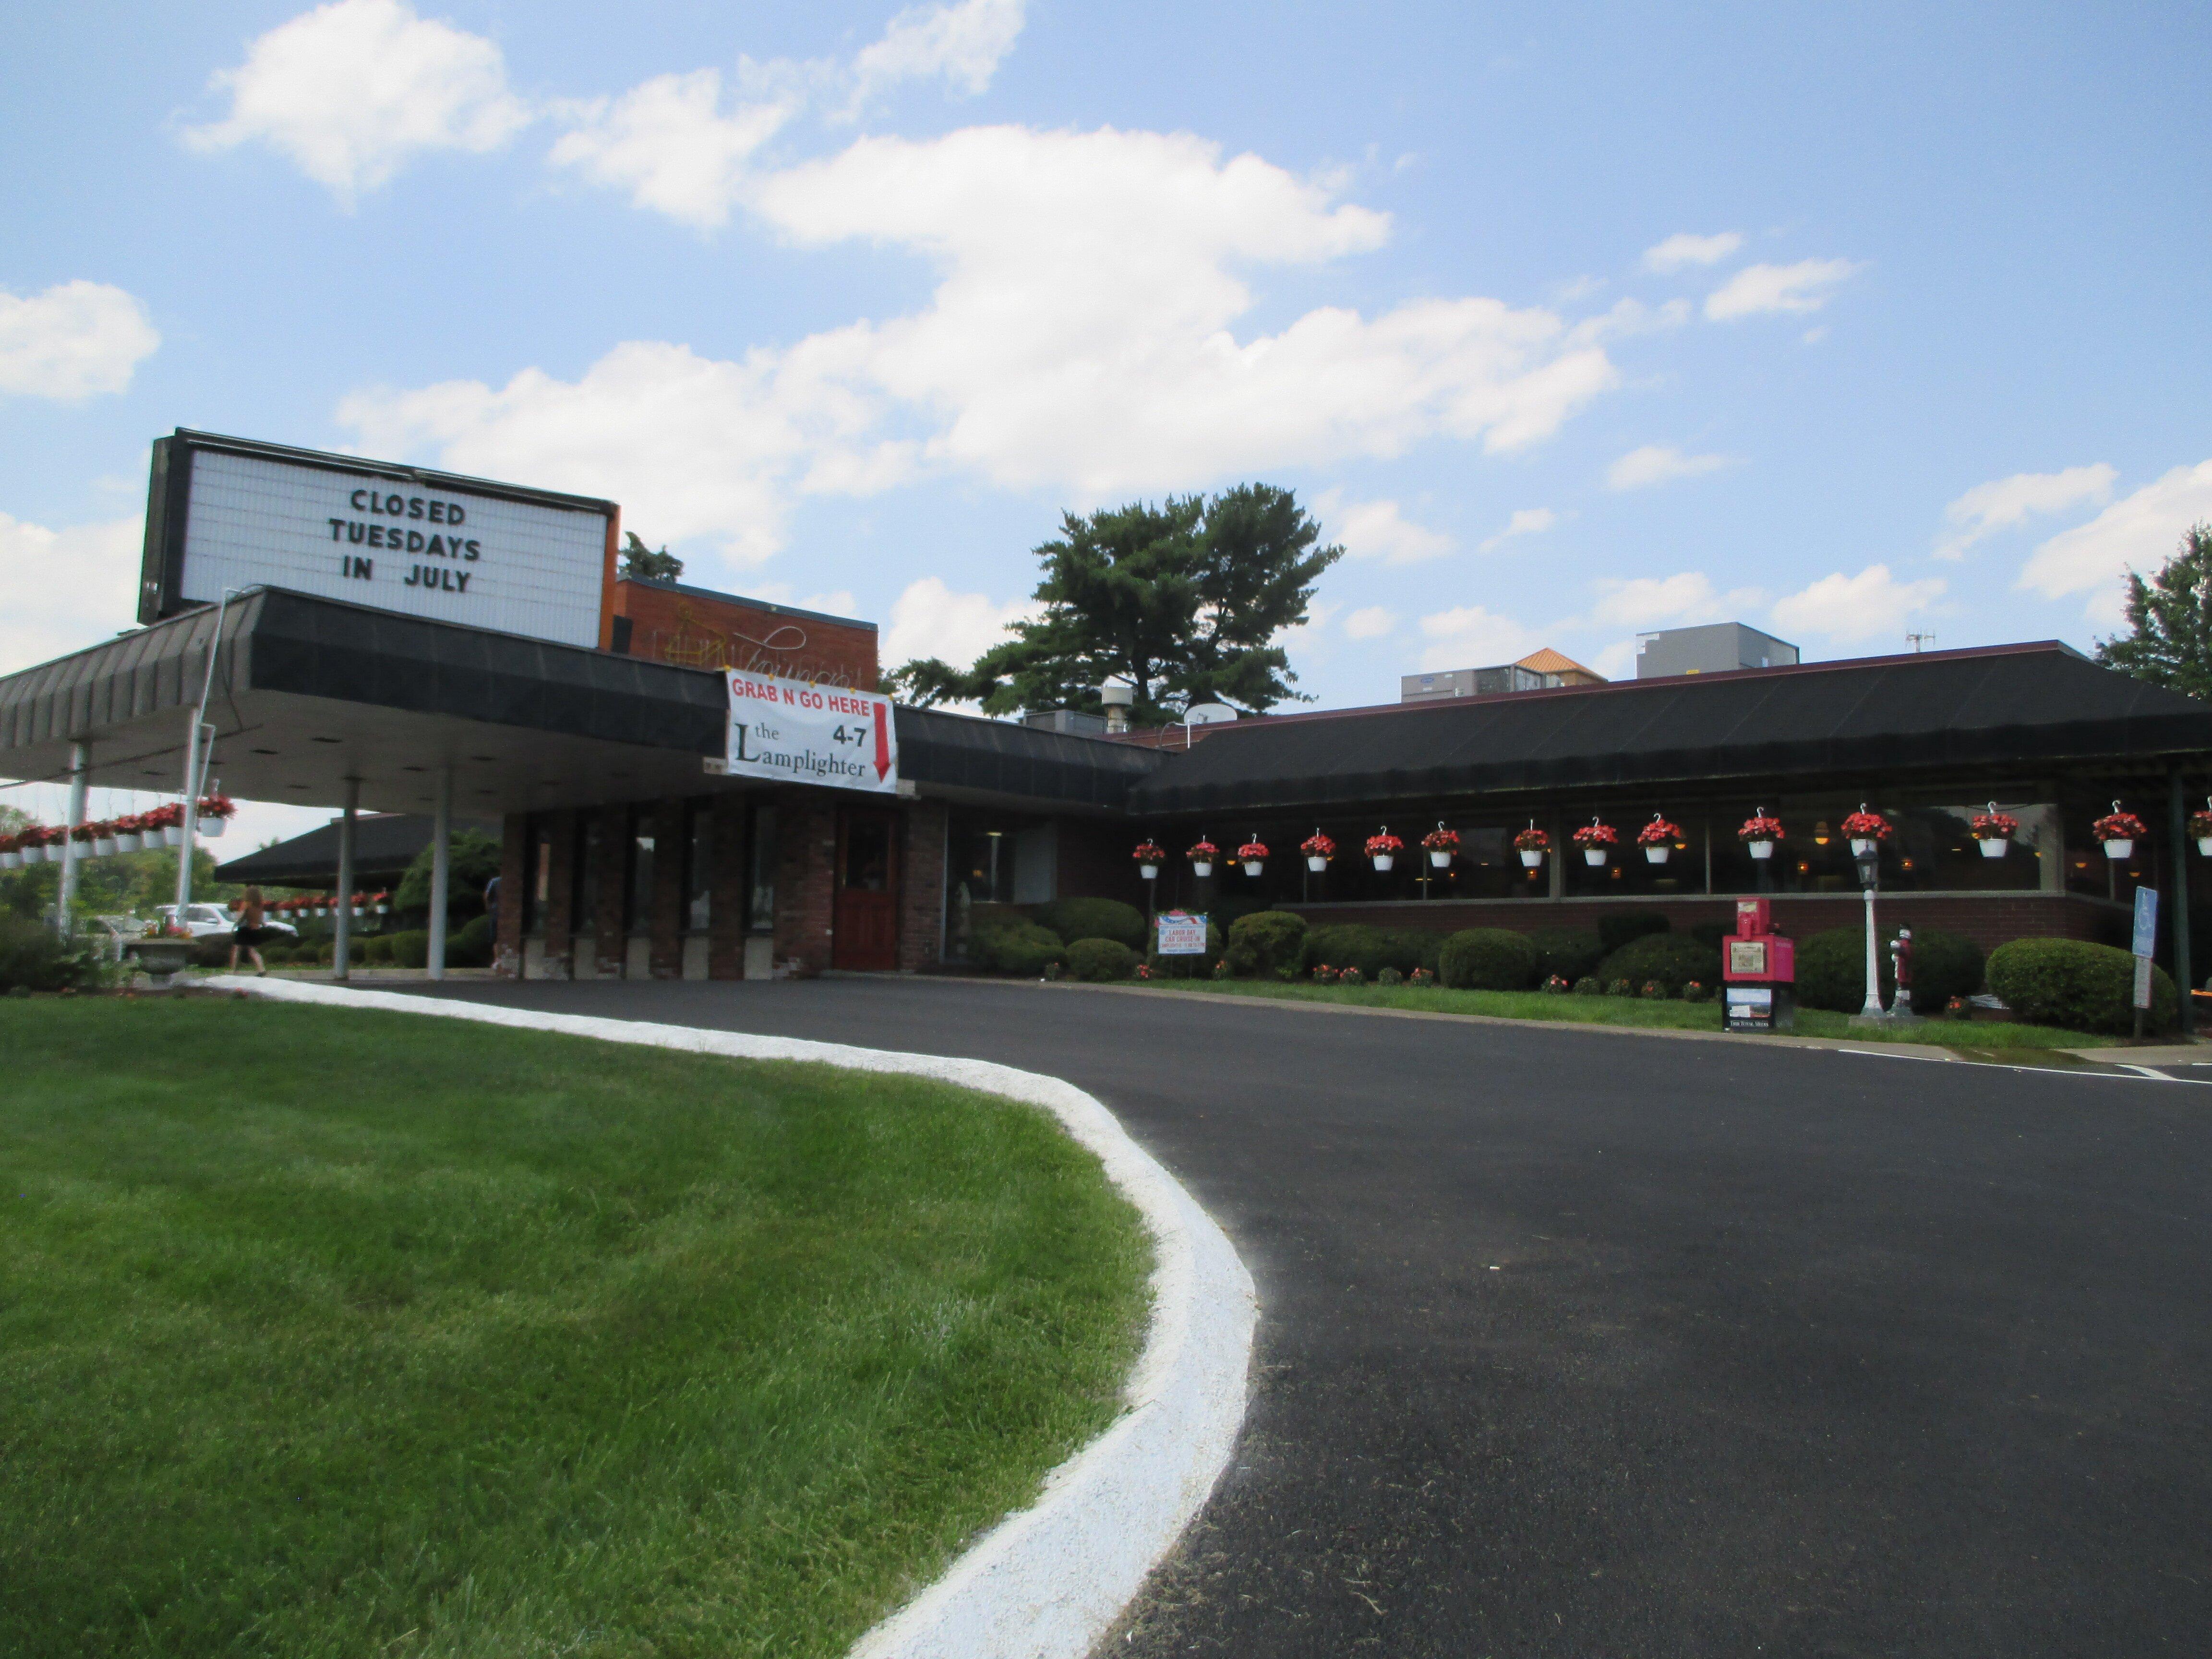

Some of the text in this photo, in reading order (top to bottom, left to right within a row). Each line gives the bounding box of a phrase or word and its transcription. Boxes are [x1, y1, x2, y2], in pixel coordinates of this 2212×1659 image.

[351, 489, 466, 526] CLOSED
[328, 518, 481, 561] TUESDAYS
[343, 555, 472, 593] IN JULY
[733, 678, 871, 717] GRAB N GO HERE
[734, 723, 866, 777] Lamplighter
[755, 722, 866, 747] the 4-7
